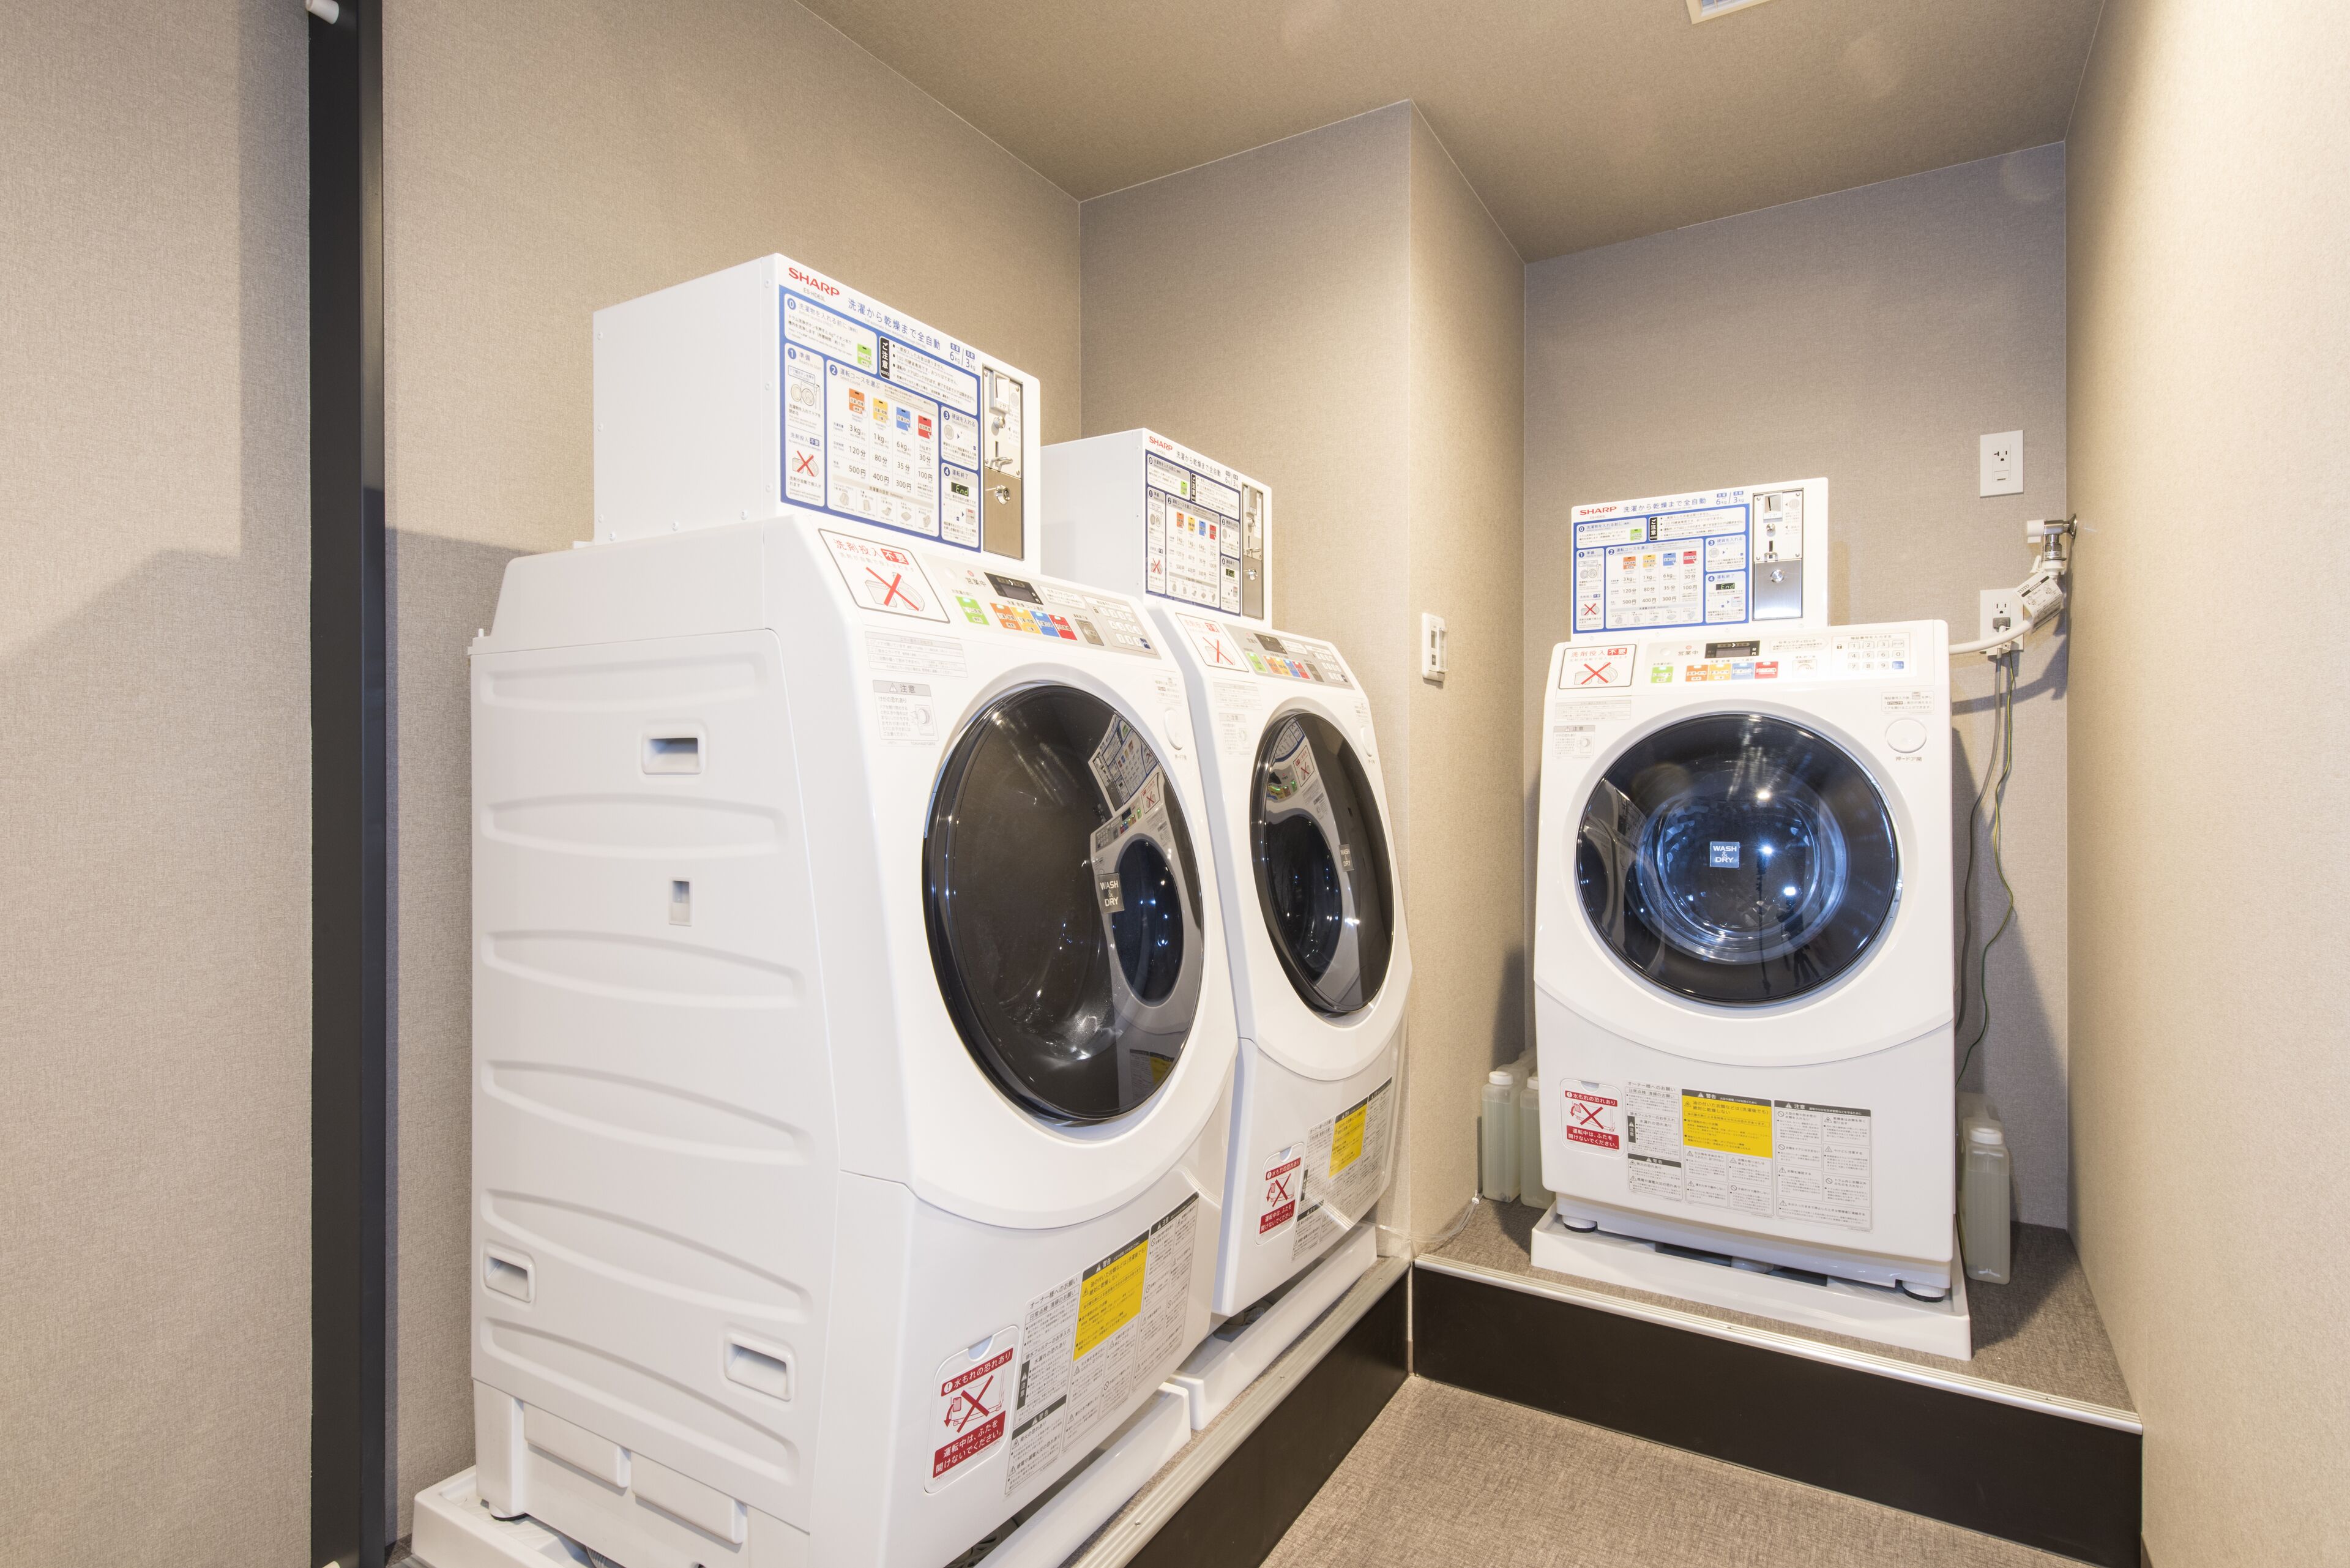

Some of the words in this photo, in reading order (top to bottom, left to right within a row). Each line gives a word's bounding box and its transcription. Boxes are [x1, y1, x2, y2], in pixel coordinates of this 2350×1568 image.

[788, 267, 840, 296] SHARP
[848, 297, 941, 351] 洗濯から乾燥まで全自動
[799, 352, 811, 362] 準備
[840, 367, 881, 389] 運転コースを選ぶ
[951, 414, 975, 428] 硬貨を入れる
[1149, 436, 1173, 451] SHARP
[849, 446, 866, 457] 120分
[874, 454, 887, 465] 80分
[919, 454, 931, 463] 30分
[1176, 450, 1222, 477] 洗濯から乾燥まで全自動
[848, 465, 866, 477] 500円
[897, 461, 910, 472] 35分
[873, 472, 889, 484] 400円
[918, 470, 933, 482] 100円
[952, 469, 969, 479] 運転終了
[896, 479, 912, 491] 300円
[955, 484, 969, 496] End
[1580, 506, 1617, 516] SHARP
[1623, 497, 1706, 513] 洗濯から乾燥まで全自動
[833, 538, 883, 558] 洗剤投入
[883, 549, 908, 565] 不要
[2017, 584, 2030, 594] TOTO
[900, 684, 916, 694] 注意
[1100, 880, 1119, 890] WASH
[1108, 889, 1113, 898] &
[1104, 897, 1119, 907] DRY
[1627, 1081, 1676, 1092] オーナー様へのお願い
[1573, 1093, 1616, 1106] 水もれの恐れあり
[1693, 1105, 1731, 1114] 絶対に乾燥しない
[1630, 1111, 1676, 1122] 排水フィルターのお手入れ
[1639, 1119, 1672, 1127] 水漏れの恐れあり
[1572, 1128, 1613, 1141] 運転中は、ふたを
[1568, 1133, 1618, 1149] 開けないでください。
[1272, 1159, 1300, 1177] 水もれの恐れあり
[1636, 1177, 1681, 1189] 感電や漏電火災の恐れあり
[1264, 1204, 1292, 1222] 運転中は、ふたを
[1102, 1258, 1111, 1269] 警告
[1089, 1272, 1119, 1296] 絶対に乾燥しない
[1029, 1277, 1078, 1310] オーナー様へのお願い
[1025, 1328, 1071, 1361] 排水フィルターのお手入れ
[1034, 1340, 1067, 1365] 水漏れの恐れあり
[953, 1351, 1011, 1389] 水もれの恐れあり
[943, 1419, 999, 1459] 運転中は、ふたを
[935, 1430, 1002, 1474] 開けないでください。
